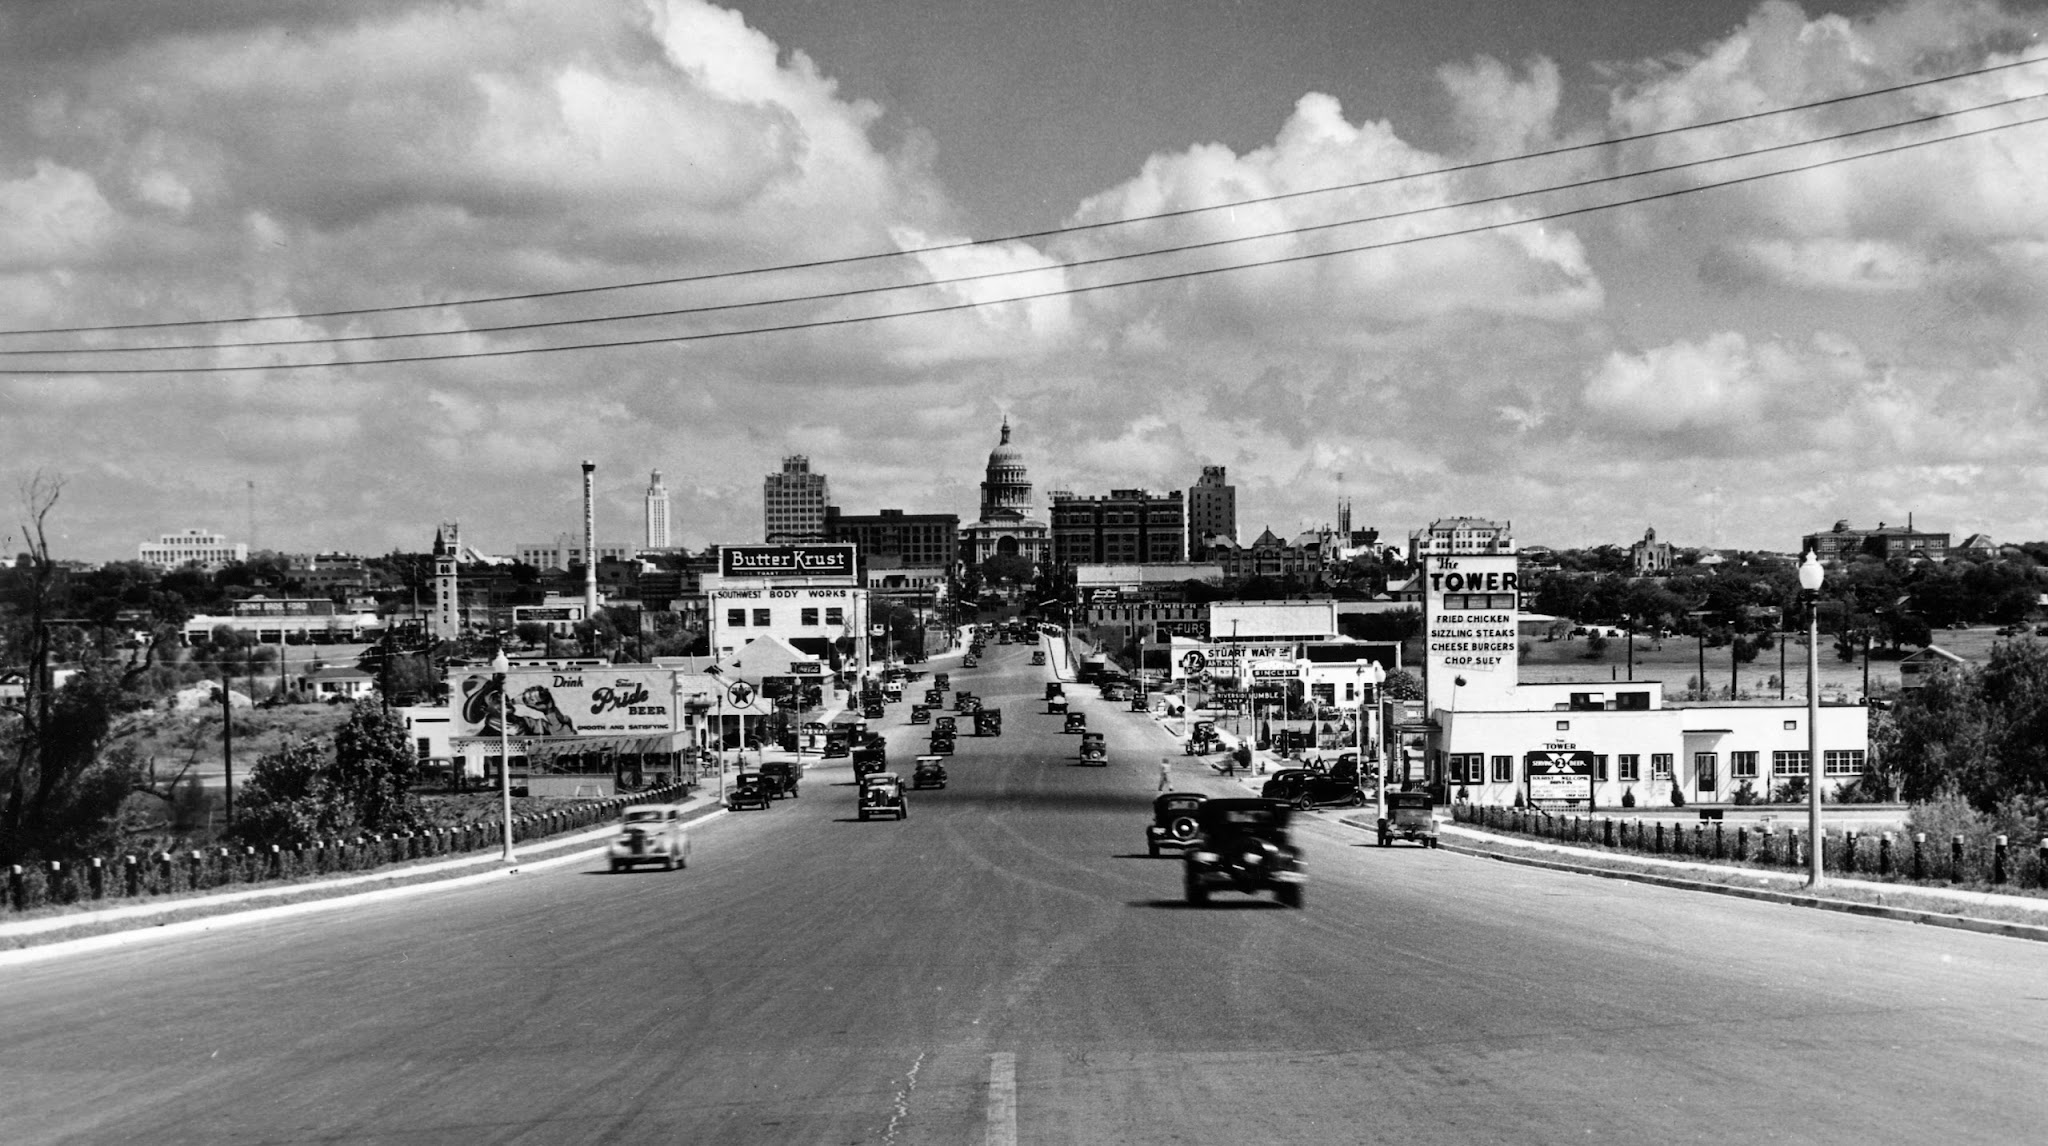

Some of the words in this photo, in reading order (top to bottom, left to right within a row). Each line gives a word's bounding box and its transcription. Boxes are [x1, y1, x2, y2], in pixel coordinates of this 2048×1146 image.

[732, 551, 790, 566] Butter
[793, 551, 845, 569] Krust
[1436, 556, 1459, 569] The
[1430, 573, 1518, 591] TOWER
[718, 591, 761, 599] SOUTHWEST
[769, 590, 798, 598] BODY
[808, 590, 846, 598] WORKS
[1437, 615, 1464, 623] FRIED
[1467, 615, 1510, 623] CHICKEN
[1431, 630, 1473, 638] SIZZLING
[1476, 629, 1515, 638] STEAKS
[1431, 643, 1469, 651] CHEESE
[1472, 643, 1515, 651] BURGERS
[1208, 649, 1246, 657] STUART
[1445, 657, 1473, 665] CHOP
[1476, 657, 1502, 665] SUEY
[553, 675, 584, 687] Drink
[590, 682, 649, 714] Pride
[628, 706, 667, 715] BEER
